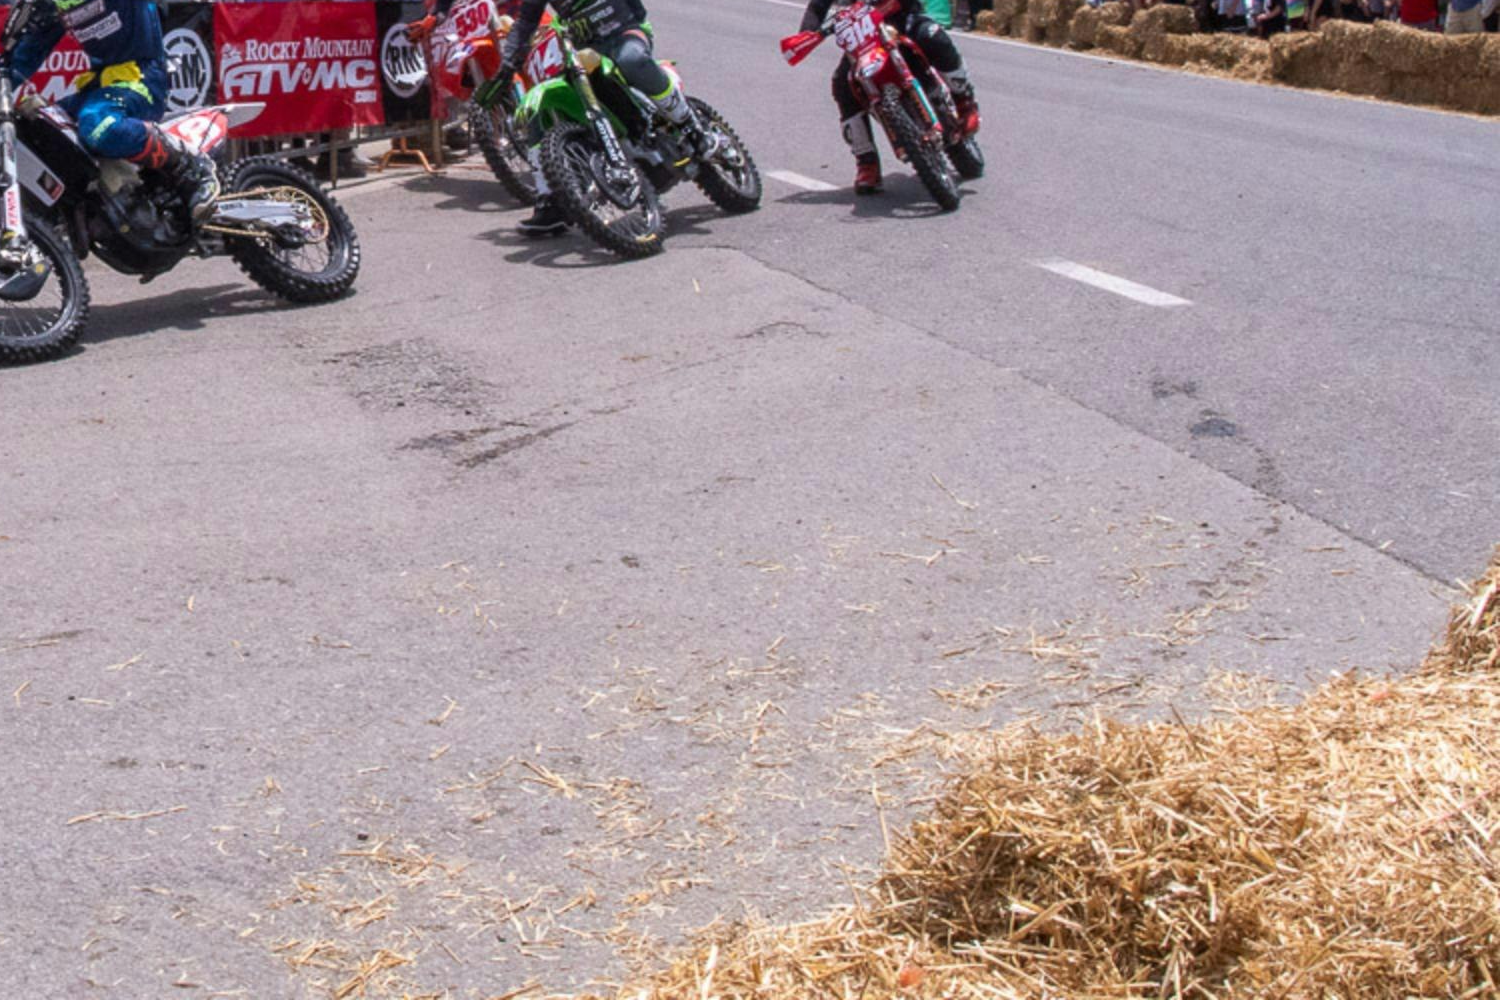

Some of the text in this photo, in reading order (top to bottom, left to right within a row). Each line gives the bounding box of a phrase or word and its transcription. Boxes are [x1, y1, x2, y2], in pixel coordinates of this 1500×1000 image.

[454, 1, 490, 38] 530
[842, 14, 876, 51] 314
[245, 37, 374, 61] ROCKY MOUNTAIN
